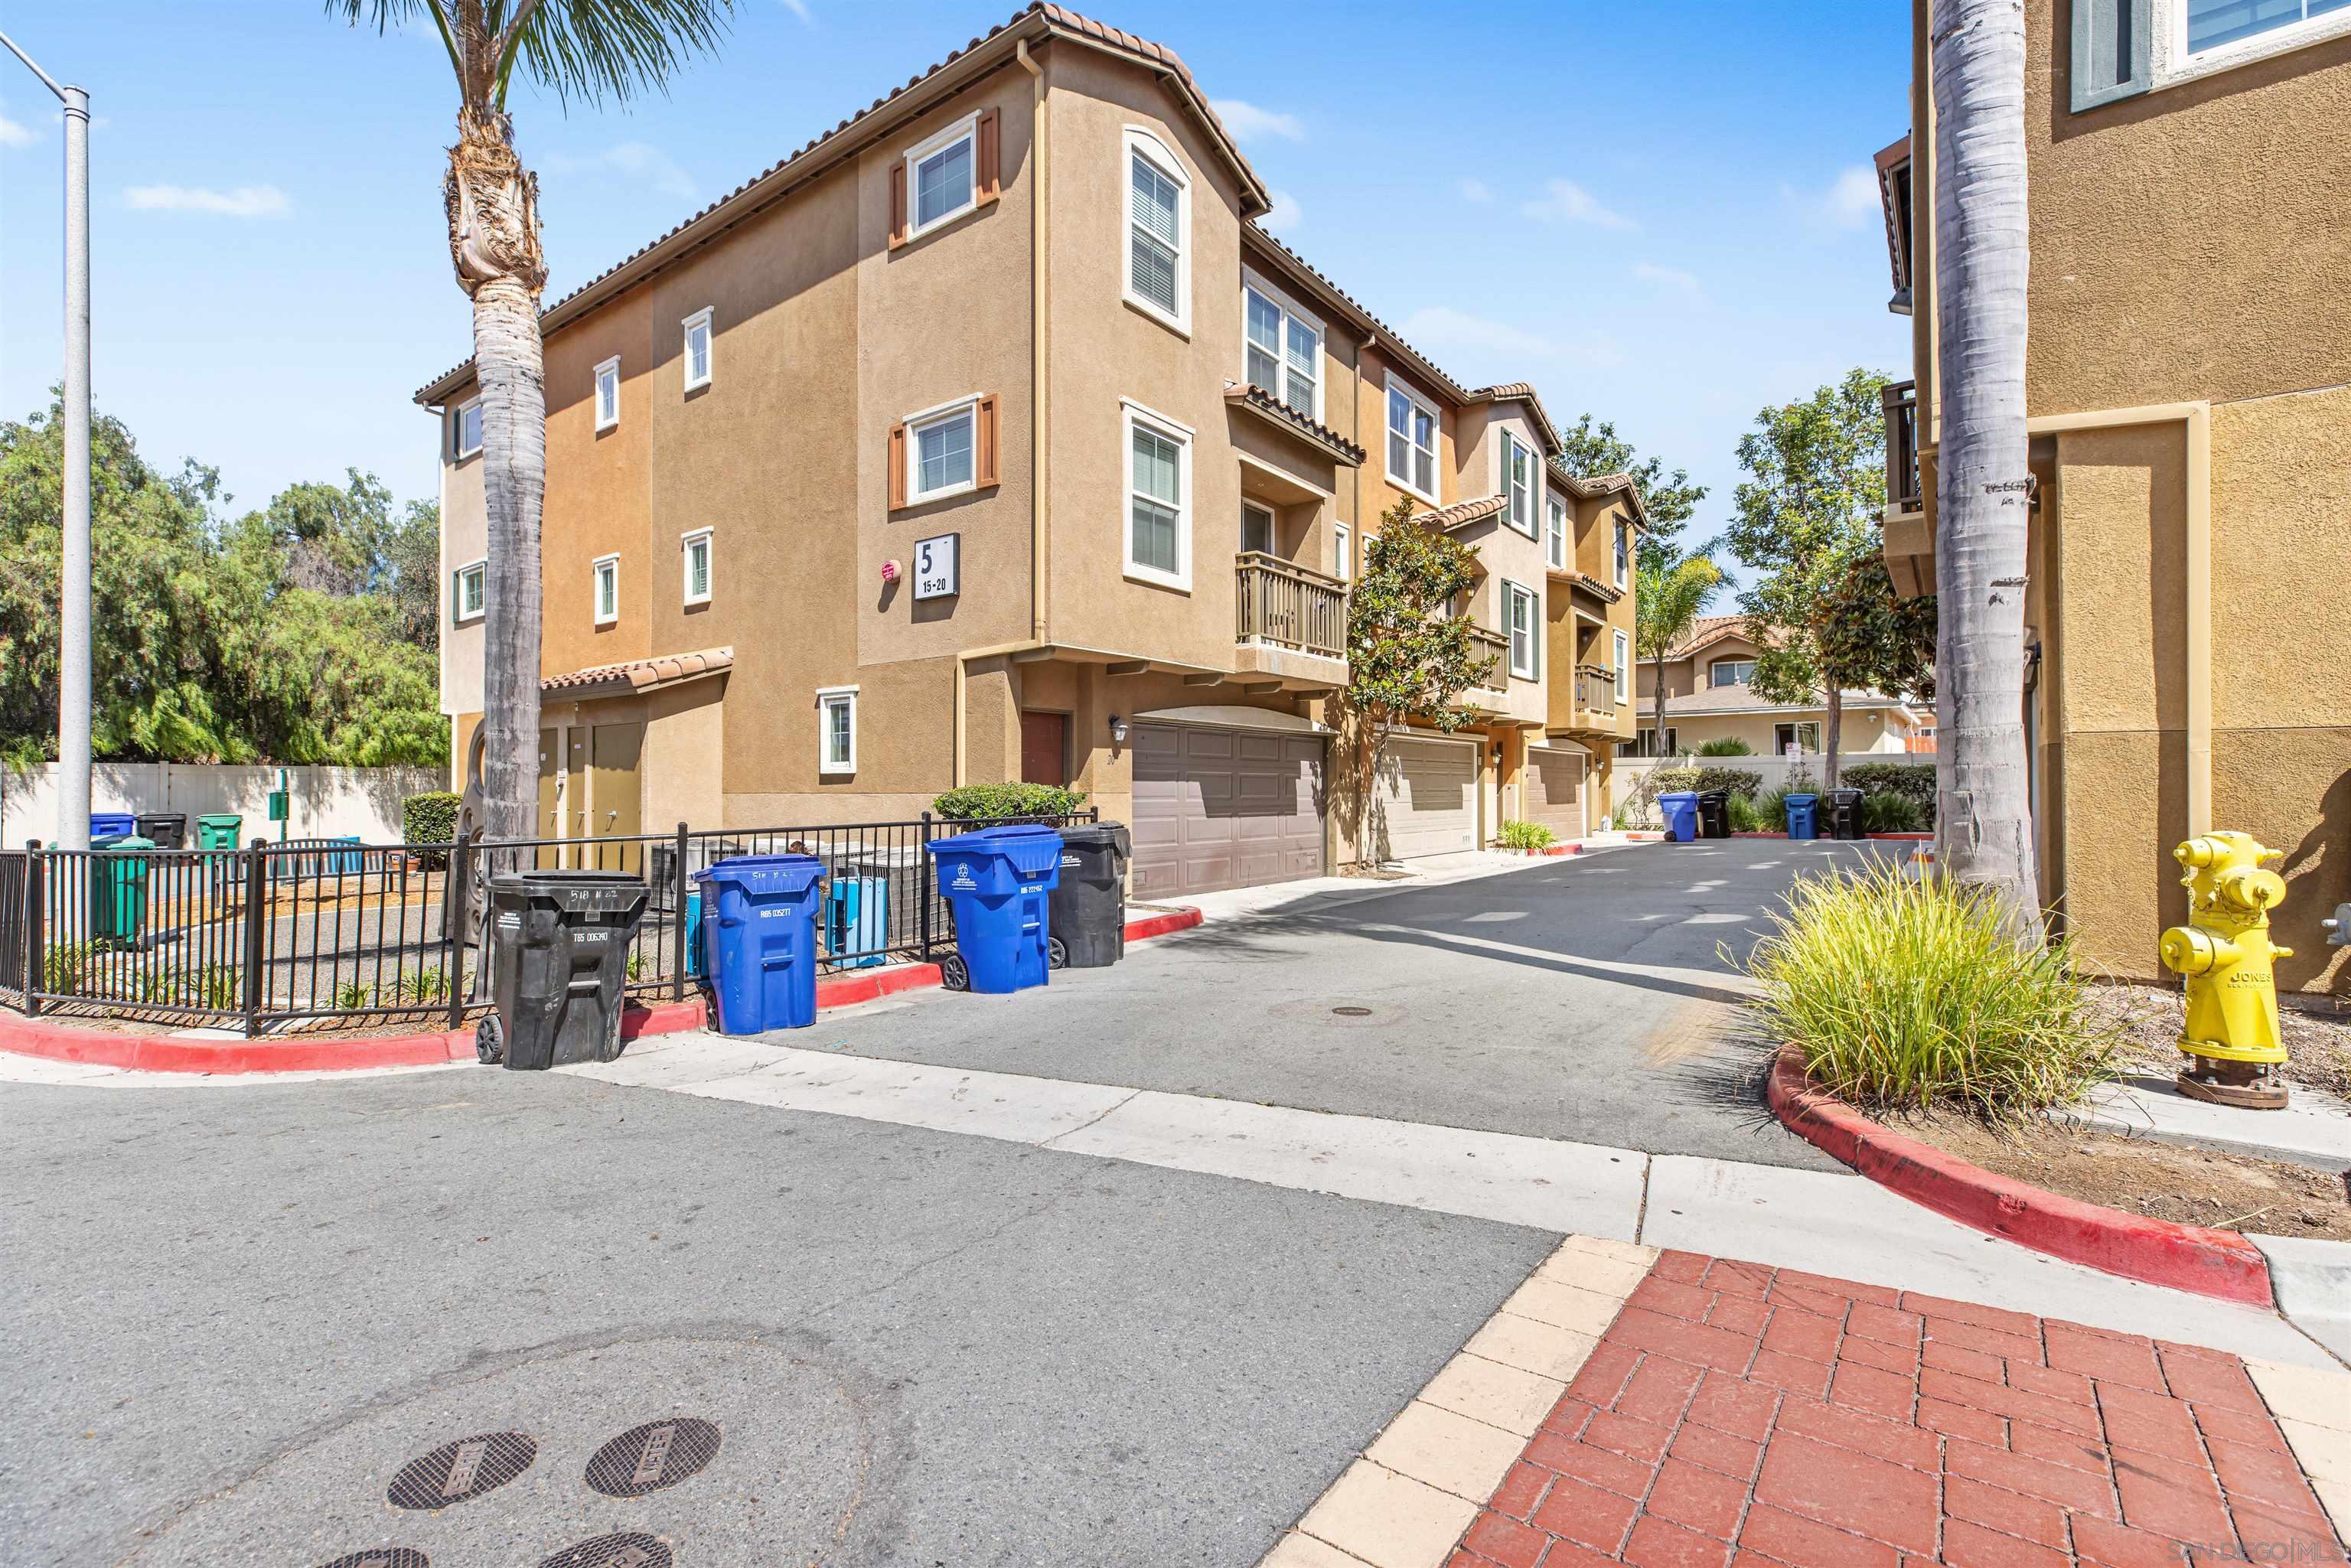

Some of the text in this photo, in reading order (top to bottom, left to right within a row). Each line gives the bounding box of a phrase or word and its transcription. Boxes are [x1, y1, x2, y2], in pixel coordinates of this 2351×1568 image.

[921, 543, 932, 575] 5
[923, 578, 946, 593] 15-20
[571, 890, 589, 902] 518
[2230, 973, 2271, 983] JONES
